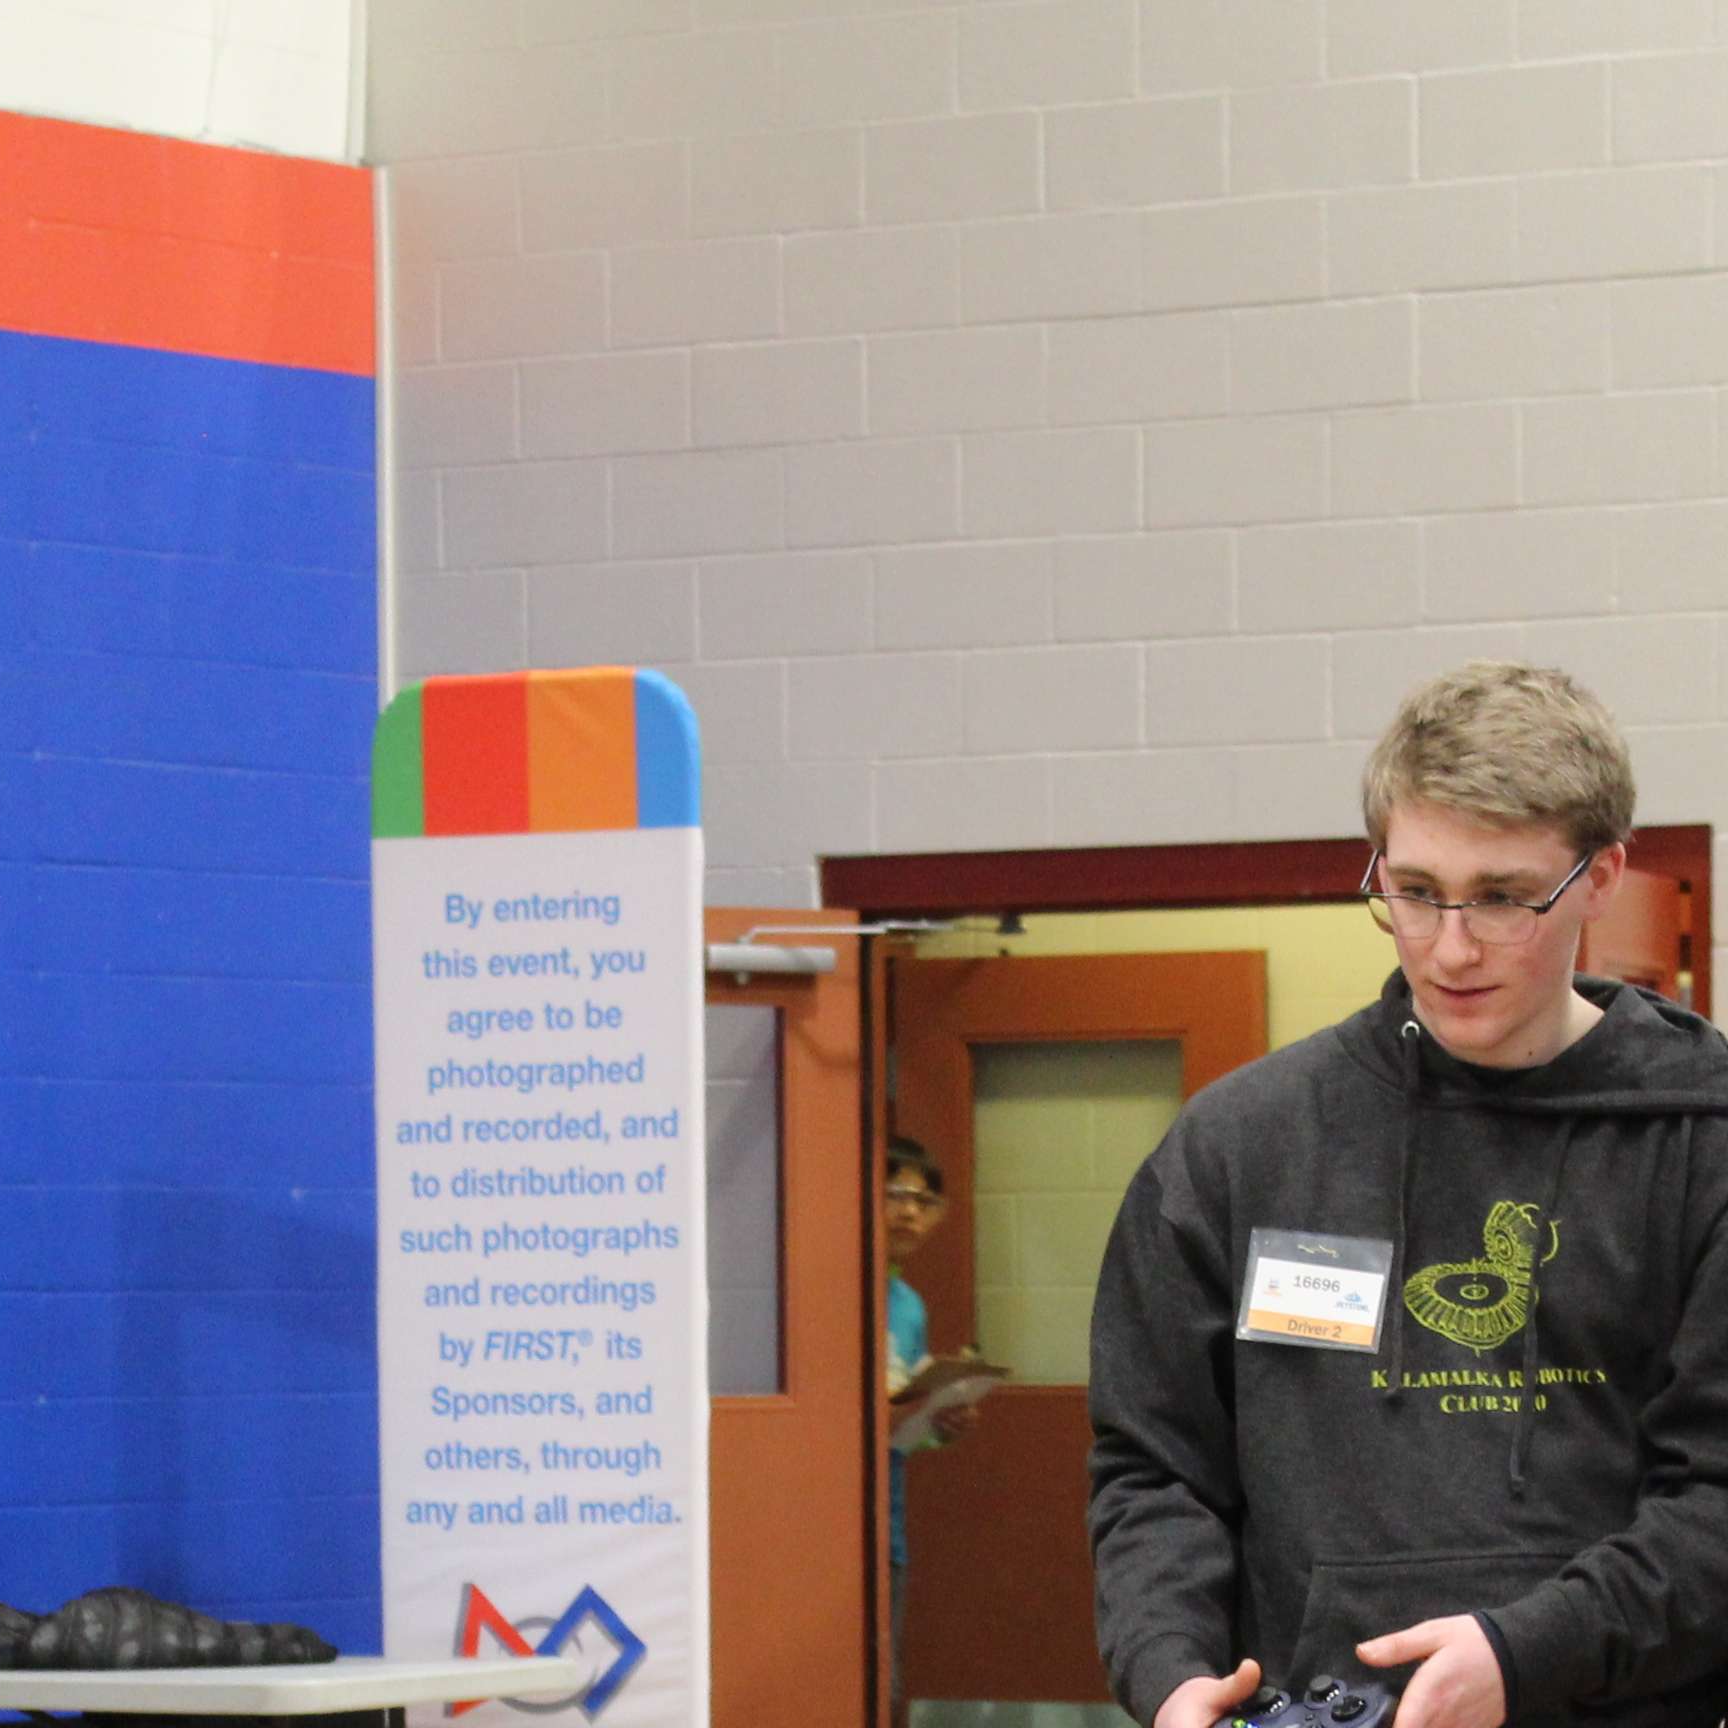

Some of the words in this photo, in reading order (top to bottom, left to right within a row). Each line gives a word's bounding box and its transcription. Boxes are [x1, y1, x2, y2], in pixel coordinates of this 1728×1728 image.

[443, 894, 483, 929] By
[493, 895, 622, 926] entering
[422, 952, 479, 978] this
[487, 948, 580, 977] event,
[591, 951, 646, 980] you
[447, 1008, 536, 1039] agree
[543, 1003, 575, 1031] to
[584, 1002, 623, 1030] be
[427, 1055, 646, 1094] photographed
[395, 1118, 454, 1145] and
[462, 1112, 609, 1143] recorded,
[622, 1109, 680, 1138] and
[410, 1171, 442, 1200] to
[450, 1167, 626, 1198] distribution
[635, 1166, 666, 1194] of
[400, 1224, 473, 1255] such
[482, 1222, 679, 1258] photographs
[423, 1279, 482, 1308] and
[489, 1275, 657, 1312] recordings
[1293, 1275, 1341, 1293] 16696
[1287, 1318, 1329, 1336] Driver
[1332, 1325, 1343, 1338] 2
[438, 1333, 475, 1365] by
[607, 1332, 642, 1360] its
[1371, 1369, 1503, 1389] KLAMALKA
[1508, 1367, 1607, 1389] RBOTICS
[431, 1384, 585, 1420] Sponsors,
[595, 1386, 655, 1415] and
[423, 1440, 530, 1472] others,
[540, 1442, 662, 1478] through
[405, 1501, 459, 1531] any
[467, 1495, 526, 1526] and
[535, 1495, 569, 1525] all
[578, 1496, 683, 1527] media.
